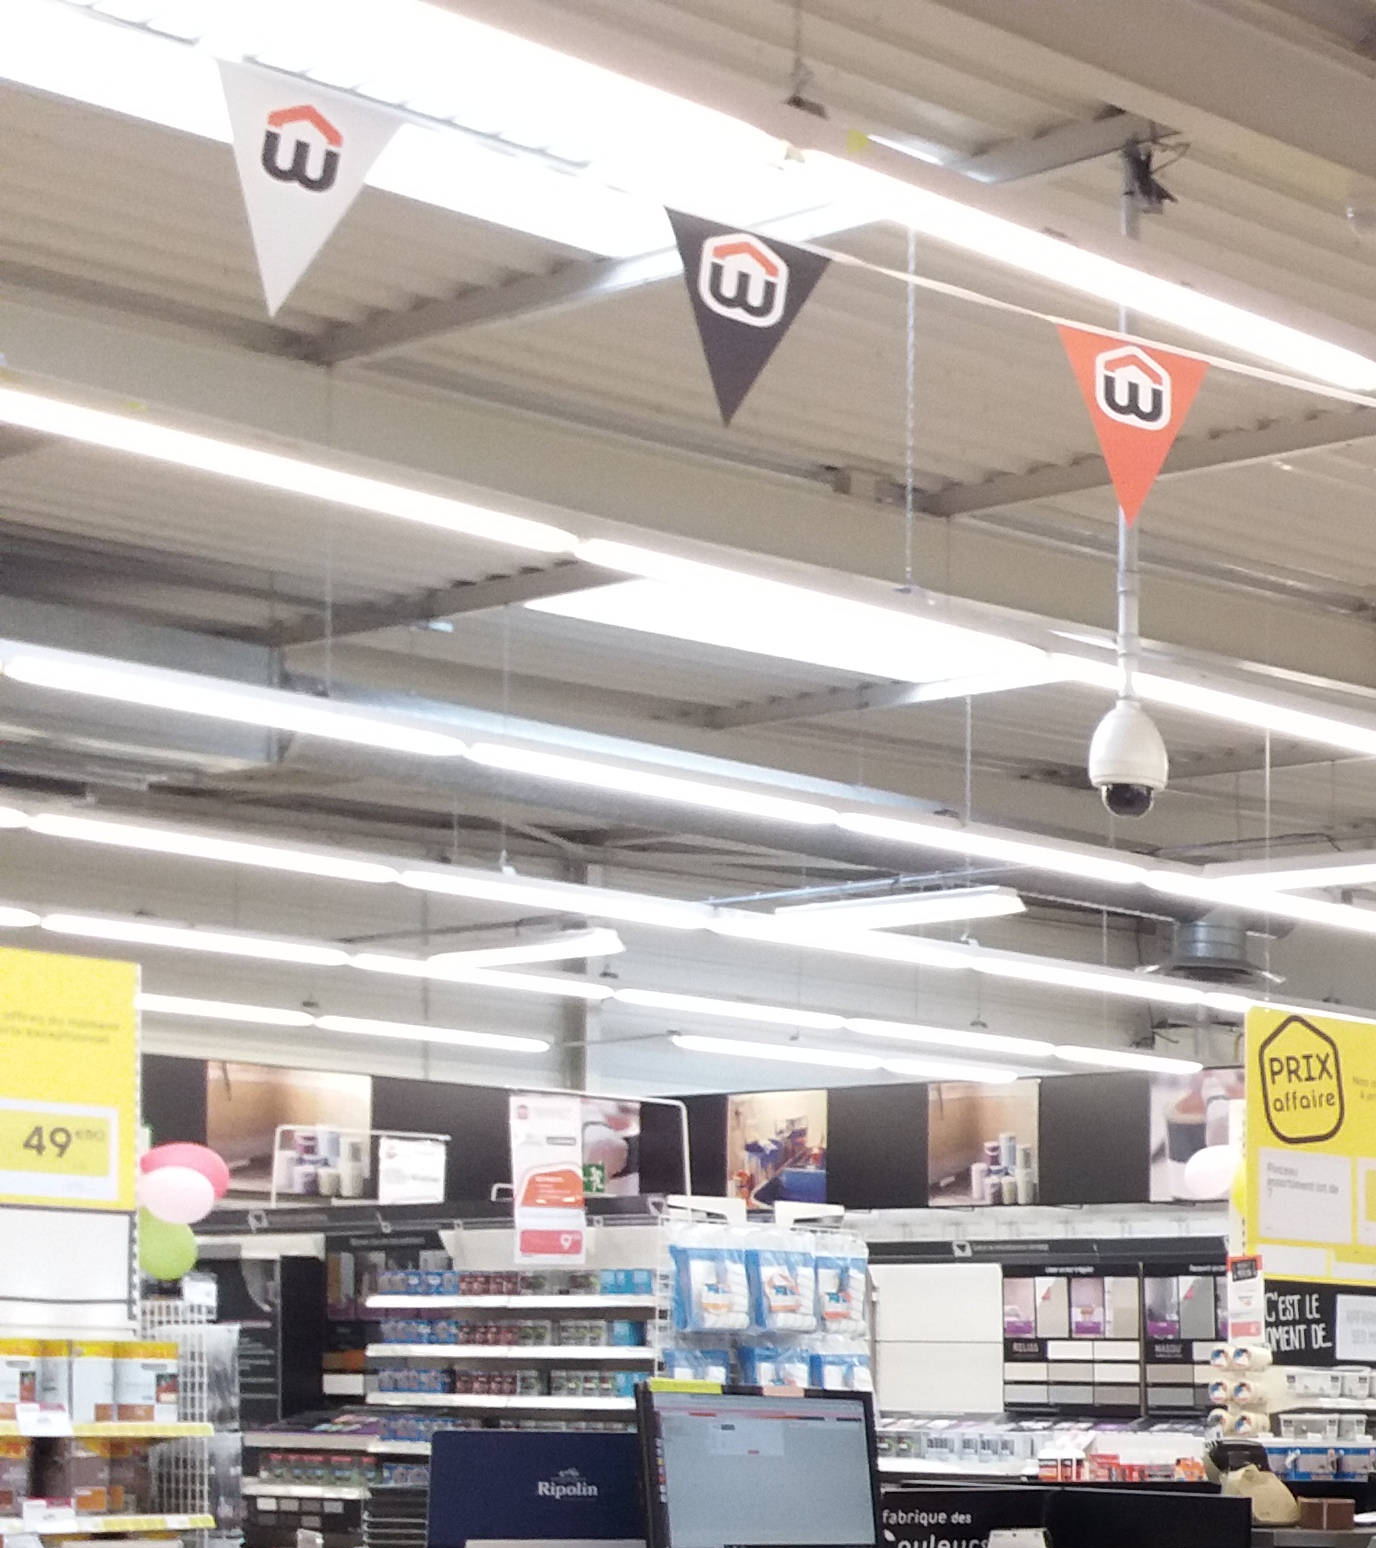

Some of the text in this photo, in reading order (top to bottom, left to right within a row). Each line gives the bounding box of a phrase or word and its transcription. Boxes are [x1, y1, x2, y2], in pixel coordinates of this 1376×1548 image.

[1269, 1052, 1333, 1085] PRIX
[1273, 1090, 1336, 1113] affaire
[1305, 1293, 1320, 1320] LE
[537, 1481, 599, 1500] Ripolin
[882, 1509, 972, 1527] fabrique des
